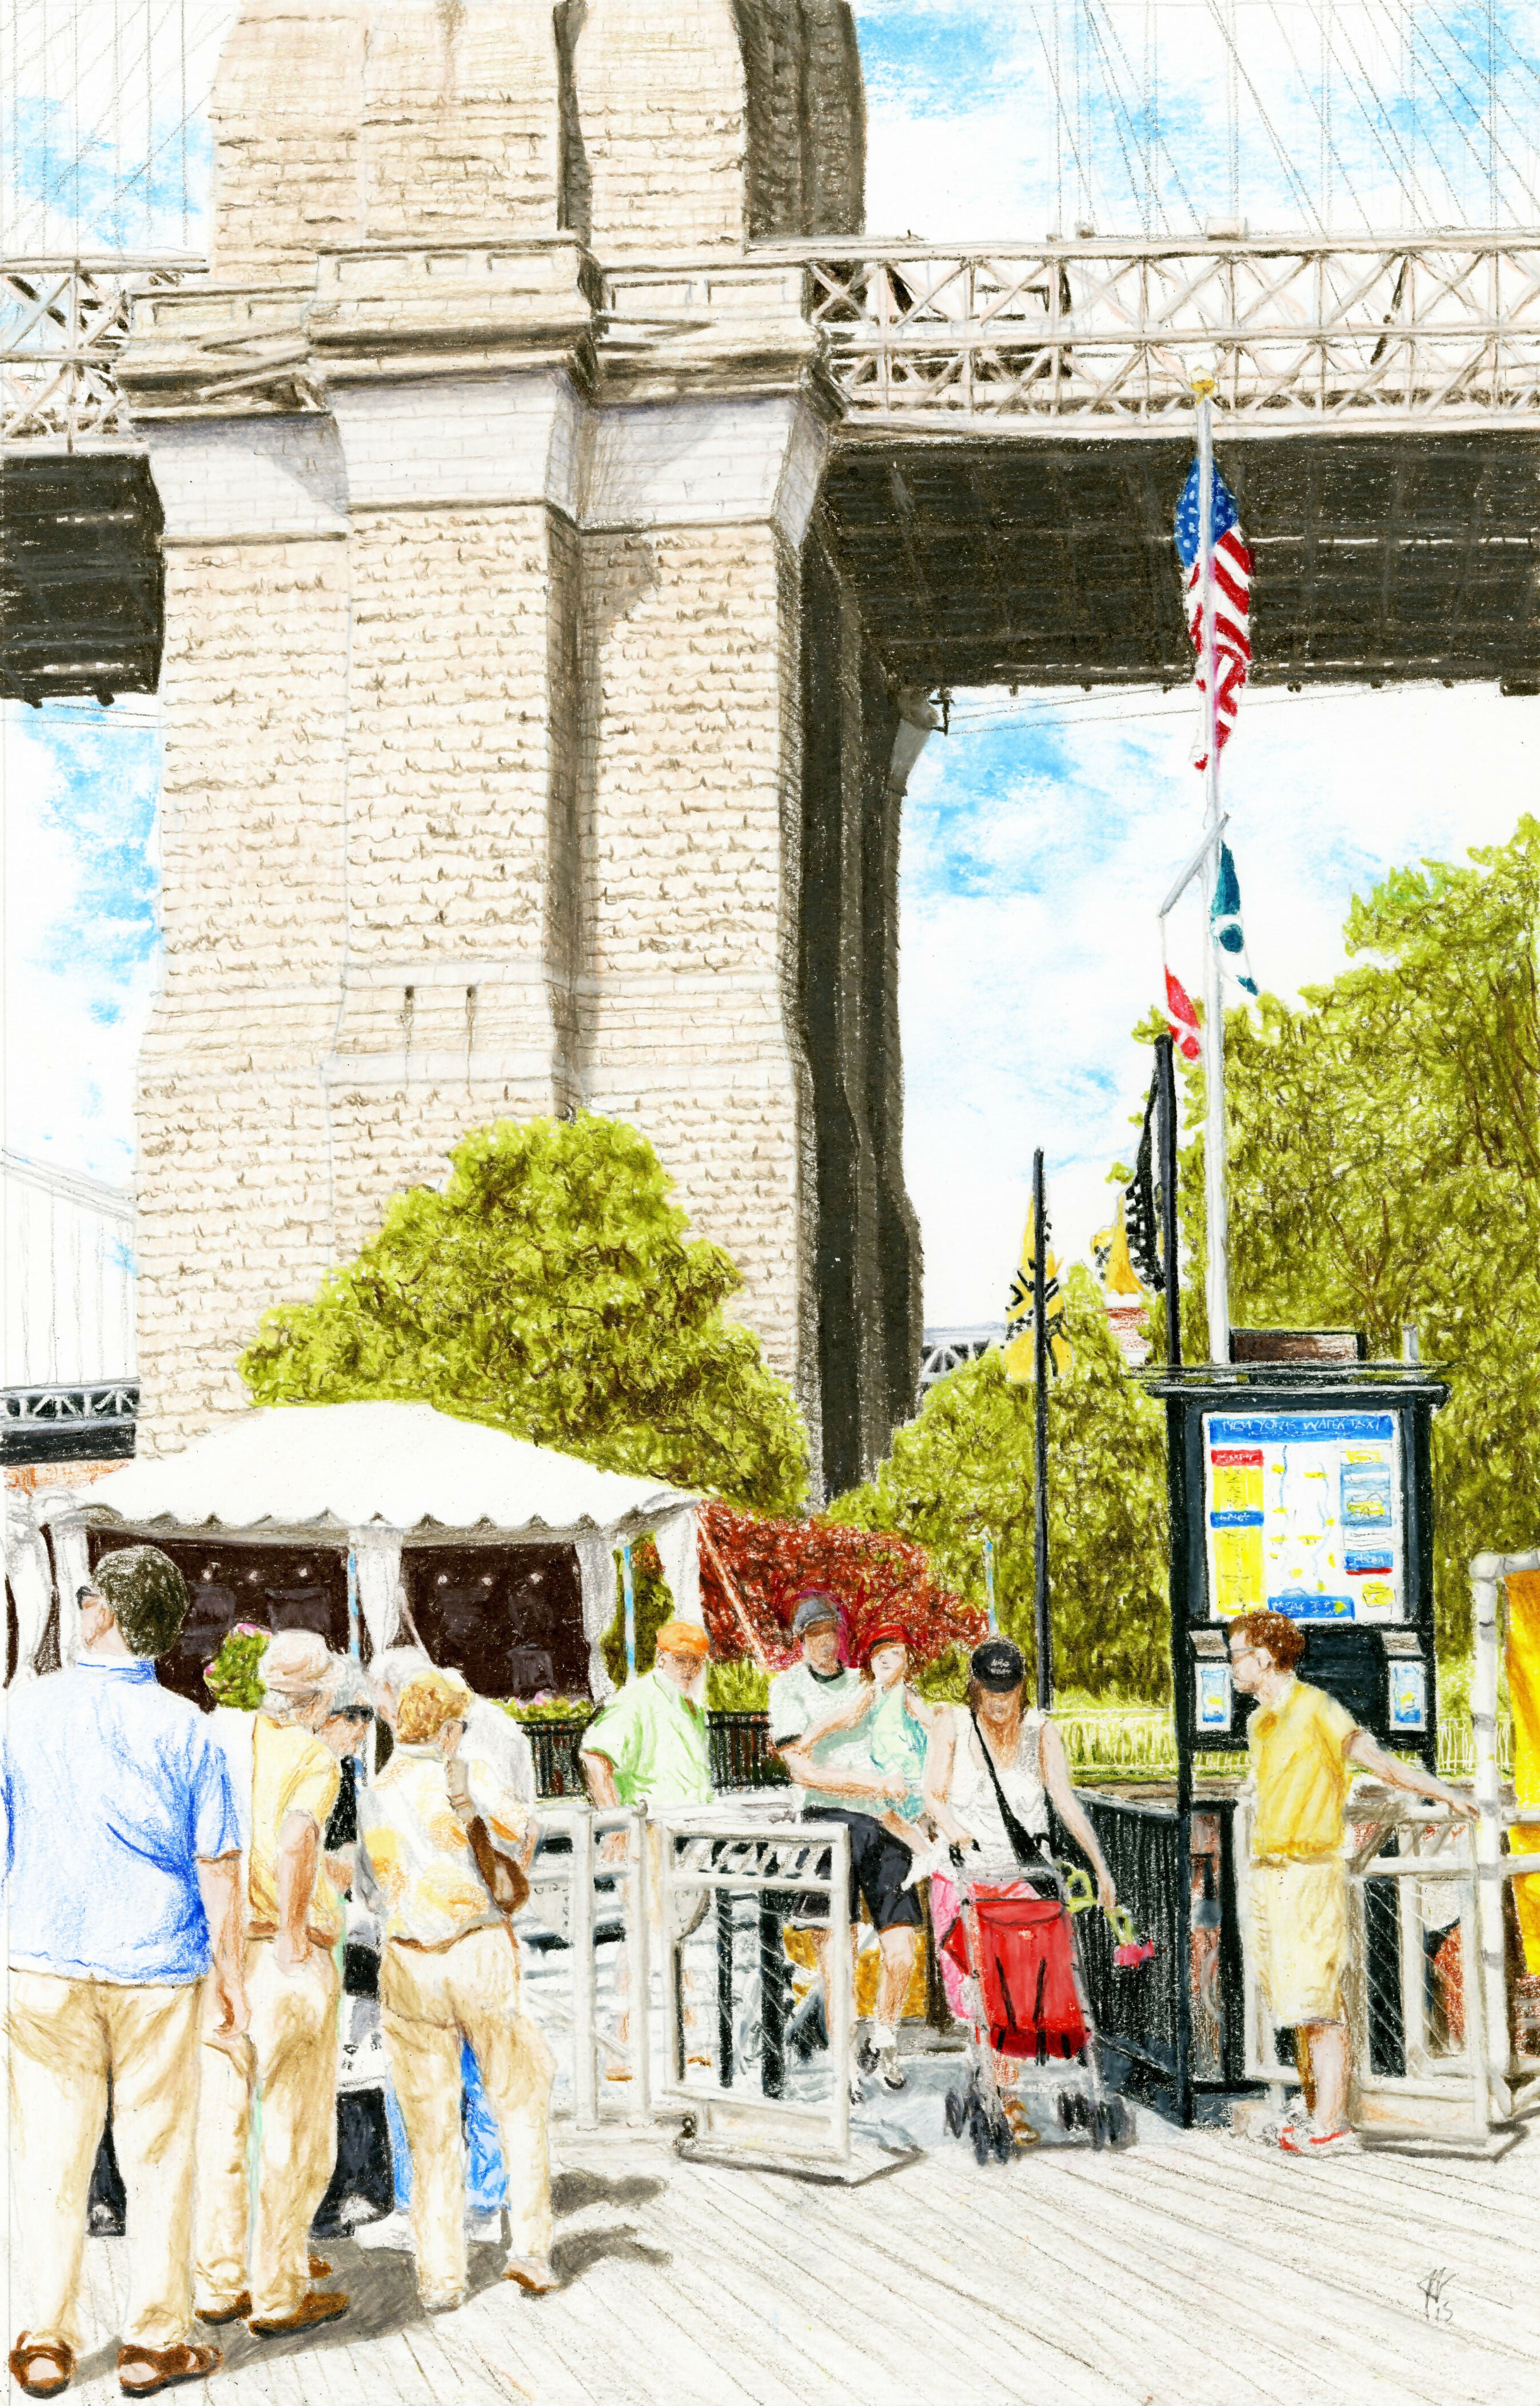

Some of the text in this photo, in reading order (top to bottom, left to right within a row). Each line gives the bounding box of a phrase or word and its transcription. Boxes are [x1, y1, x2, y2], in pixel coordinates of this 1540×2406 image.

[1222, 1418, 1380, 1432] NEW YORK WATER TAXI
